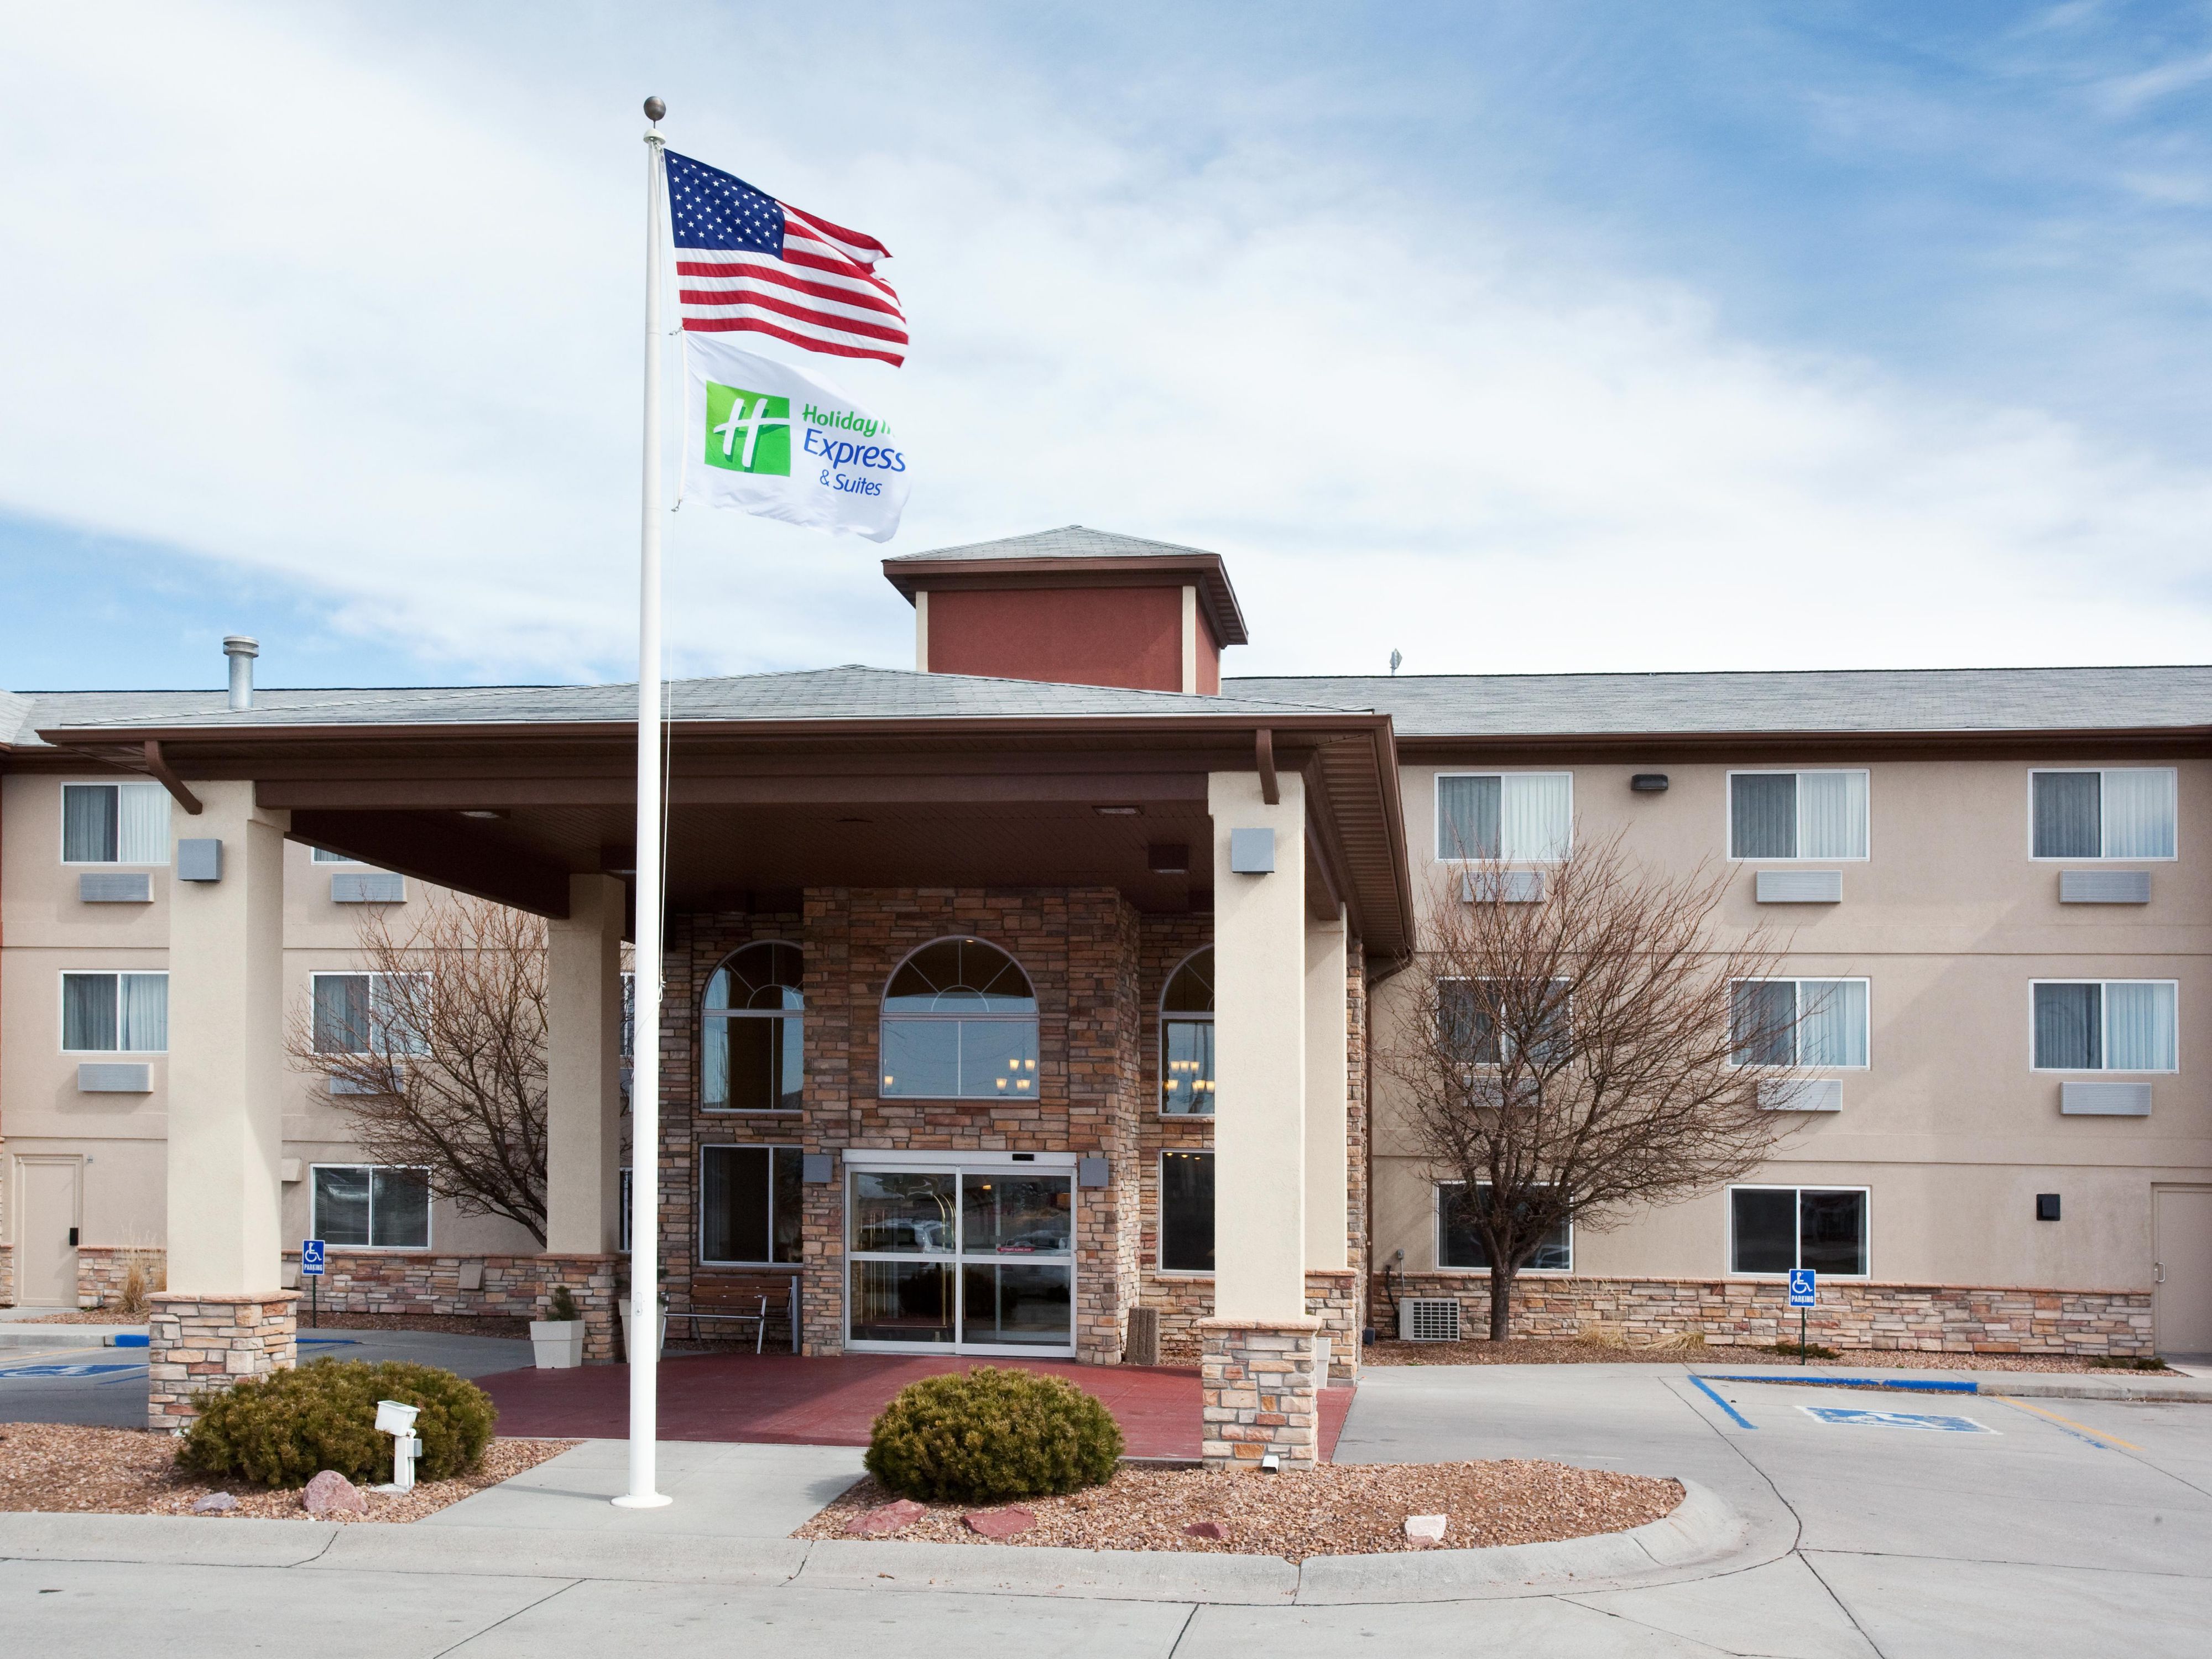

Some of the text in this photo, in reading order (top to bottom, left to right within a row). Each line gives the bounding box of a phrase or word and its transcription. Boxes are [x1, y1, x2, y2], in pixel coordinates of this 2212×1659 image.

[802, 403, 879, 437] Holiday
[804, 427, 906, 472] Express
[820, 469, 883, 496] & Suites
